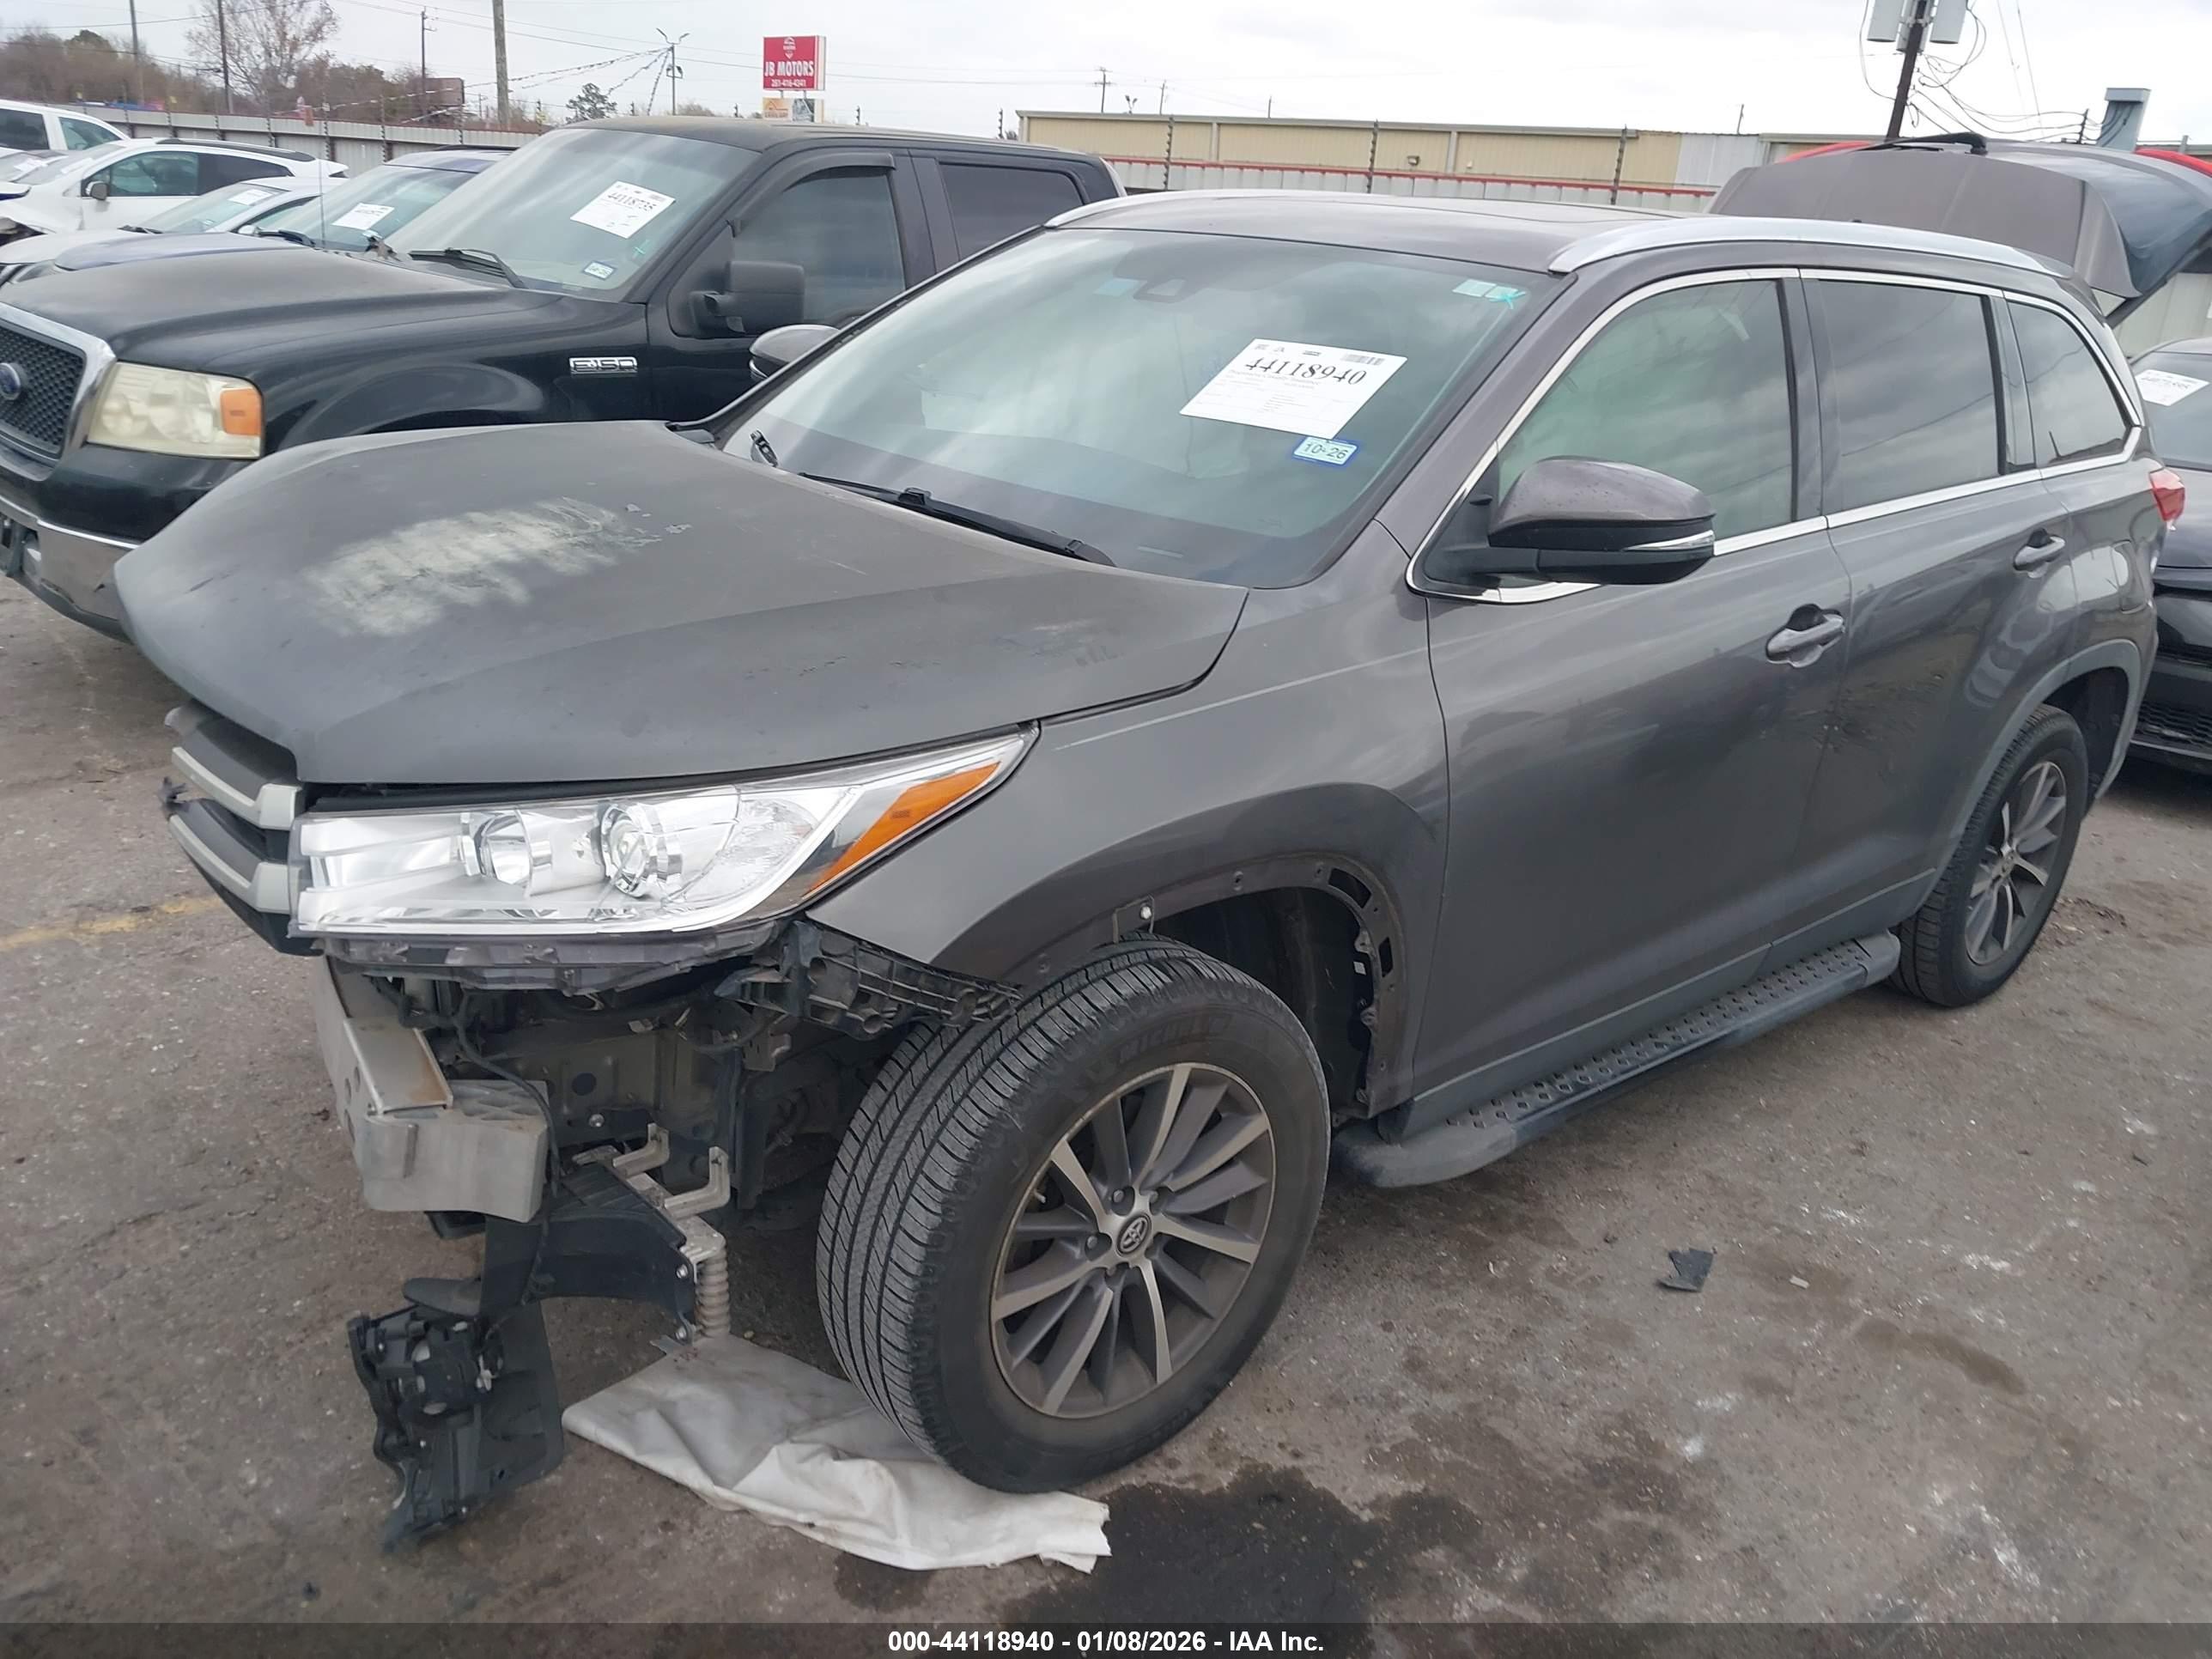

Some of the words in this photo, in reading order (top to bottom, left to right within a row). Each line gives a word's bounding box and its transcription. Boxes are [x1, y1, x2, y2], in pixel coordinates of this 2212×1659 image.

[764, 61, 775, 76] JB
[776, 60, 814, 76] MOTORS
[1245, 357, 1367, 386] 44118940
